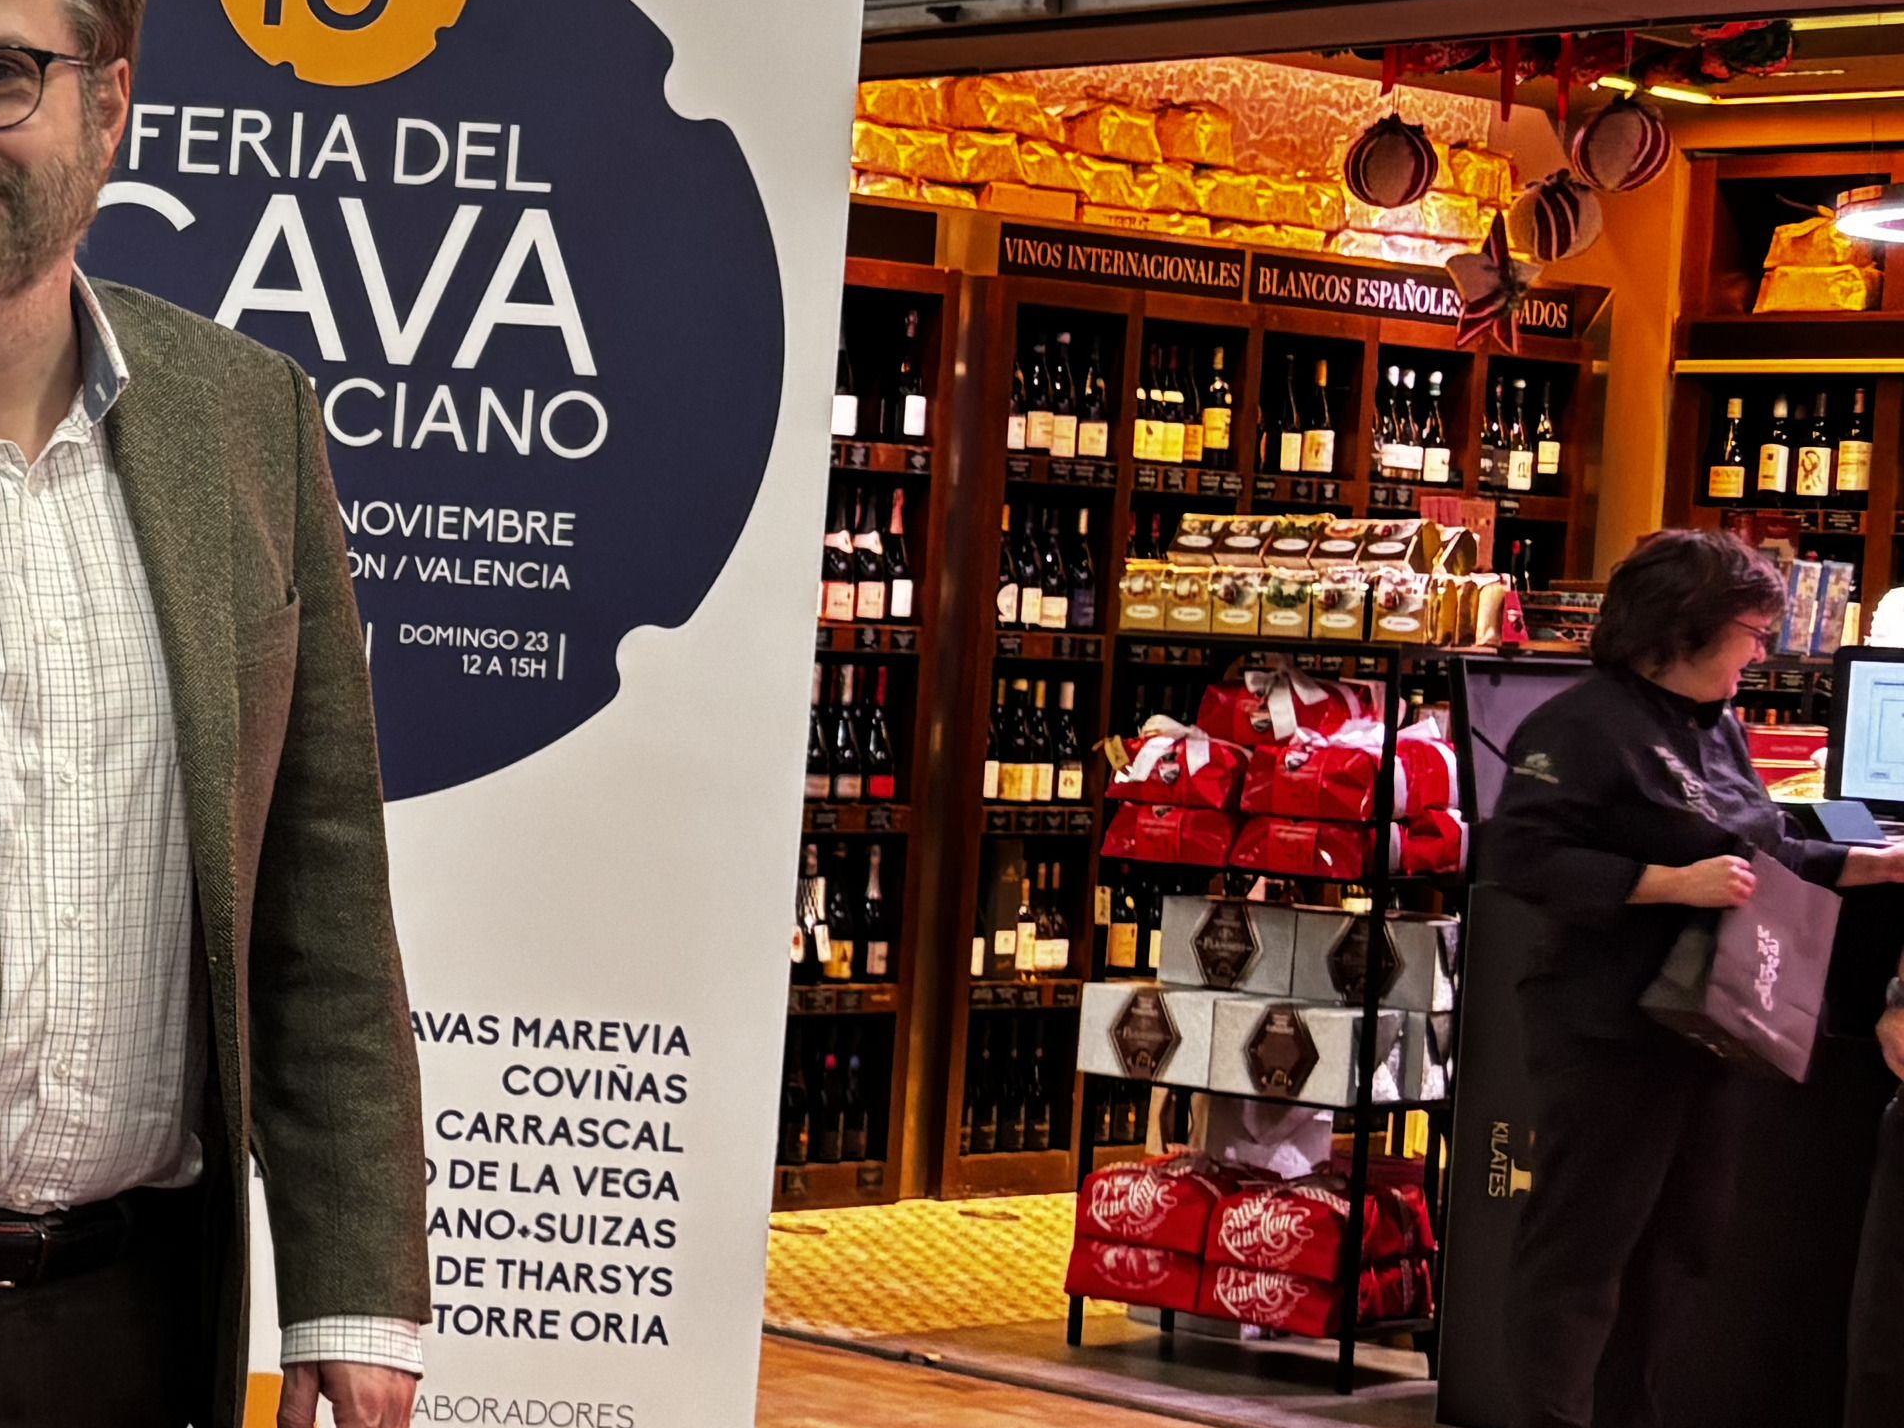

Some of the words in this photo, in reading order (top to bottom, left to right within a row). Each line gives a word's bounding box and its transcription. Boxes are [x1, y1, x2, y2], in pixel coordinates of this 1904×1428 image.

[128, 104, 367, 182] FERIA
[392, 118, 552, 194] DEL
[1005, 236, 1063, 268] VINOS
[1067, 244, 1241, 288] INTERNACIONALES
[1258, 266, 1352, 305] BLANCOS
[1519, 298, 1569, 329] ADOS
[309, 376, 608, 459] CIANO
[337, 499, 576, 547] NOVIEMBRE
[393, 554, 408, 581] /
[414, 555, 572, 591] VALENCIA
[399, 623, 519, 650] DOMINGO
[523, 631, 549, 652] 23
[462, 654, 482, 675] 12
[486, 656, 503, 676] A
[510, 657, 547, 679] 15H
[512, 1016, 691, 1057] MAREVIA
[502, 1063, 688, 1105] COVIÑAS
[435, 1109, 684, 1153] CARRASCAL
[1488, 1121, 1510, 1197] KILATES
[449, 1159, 499, 1192] DE
[510, 1162, 560, 1195] LA
[573, 1165, 680, 1202] VEGA
[435, 1255, 486, 1288] DE
[496, 1258, 673, 1297] THARSYS
[431, 1303, 561, 1340] TORRE
[570, 1310, 669, 1346] ORIA
